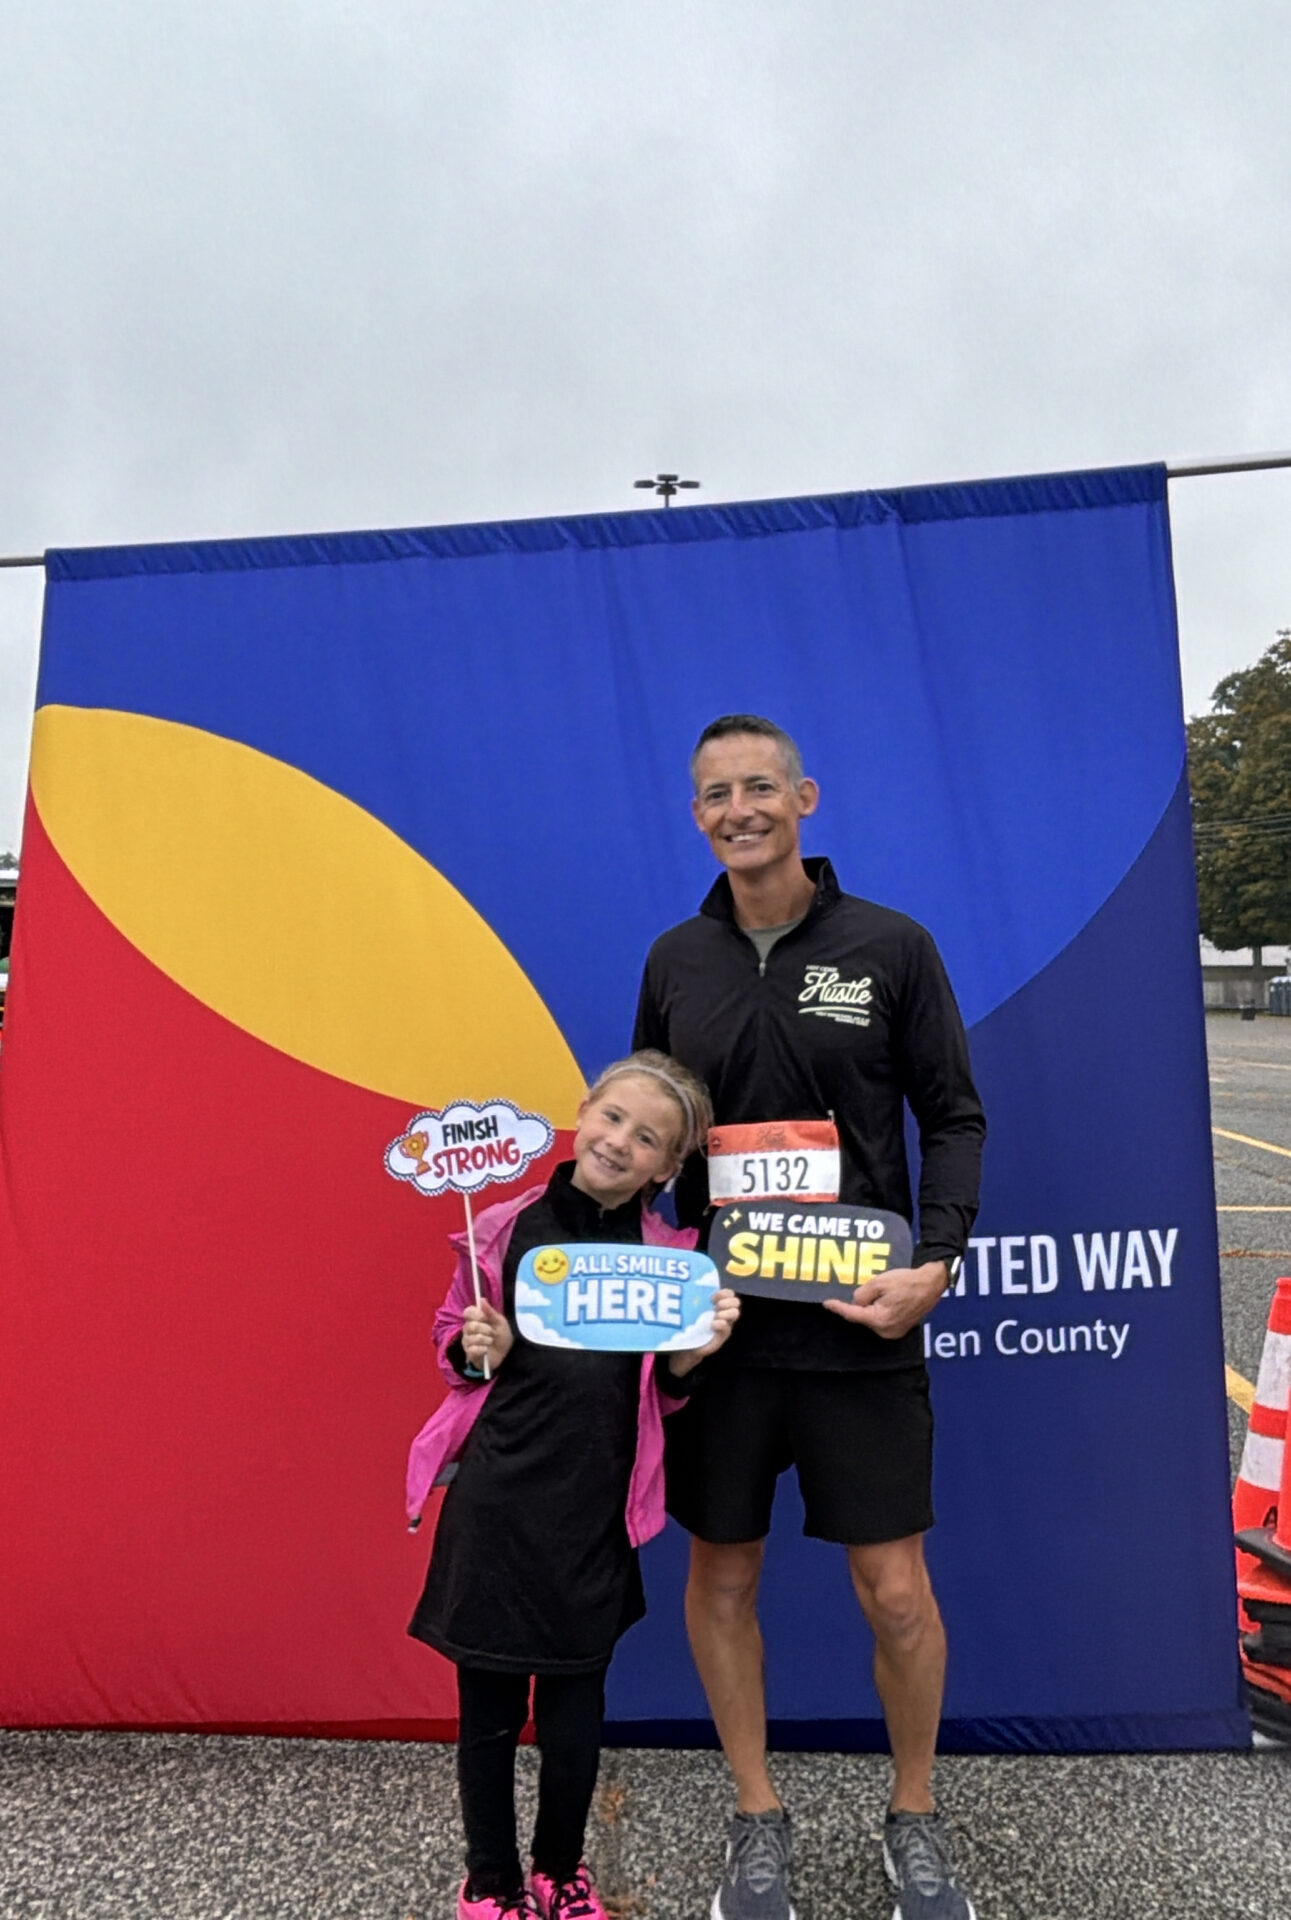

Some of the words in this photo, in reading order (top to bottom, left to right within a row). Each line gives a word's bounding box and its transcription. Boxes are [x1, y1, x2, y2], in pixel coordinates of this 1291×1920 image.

[798, 971, 873, 1005] Hustle
[442, 1114, 499, 1147] FINISH
[432, 1137, 520, 1179] STRONG
[741, 1156, 810, 1193] 5132
[748, 1211, 784, 1231] WE
[787, 1214, 850, 1237] CAME
[854, 1219, 885, 1240] TO
[571, 1255, 612, 1275] ALL
[616, 1254, 690, 1281] SMILES
[725, 1231, 891, 1285] SHINE
[1072, 1228, 1179, 1292] WAY
[564, 1278, 683, 1327] HERE
[923, 1322, 981, 1358] len
[994, 1318, 1130, 1360] County
